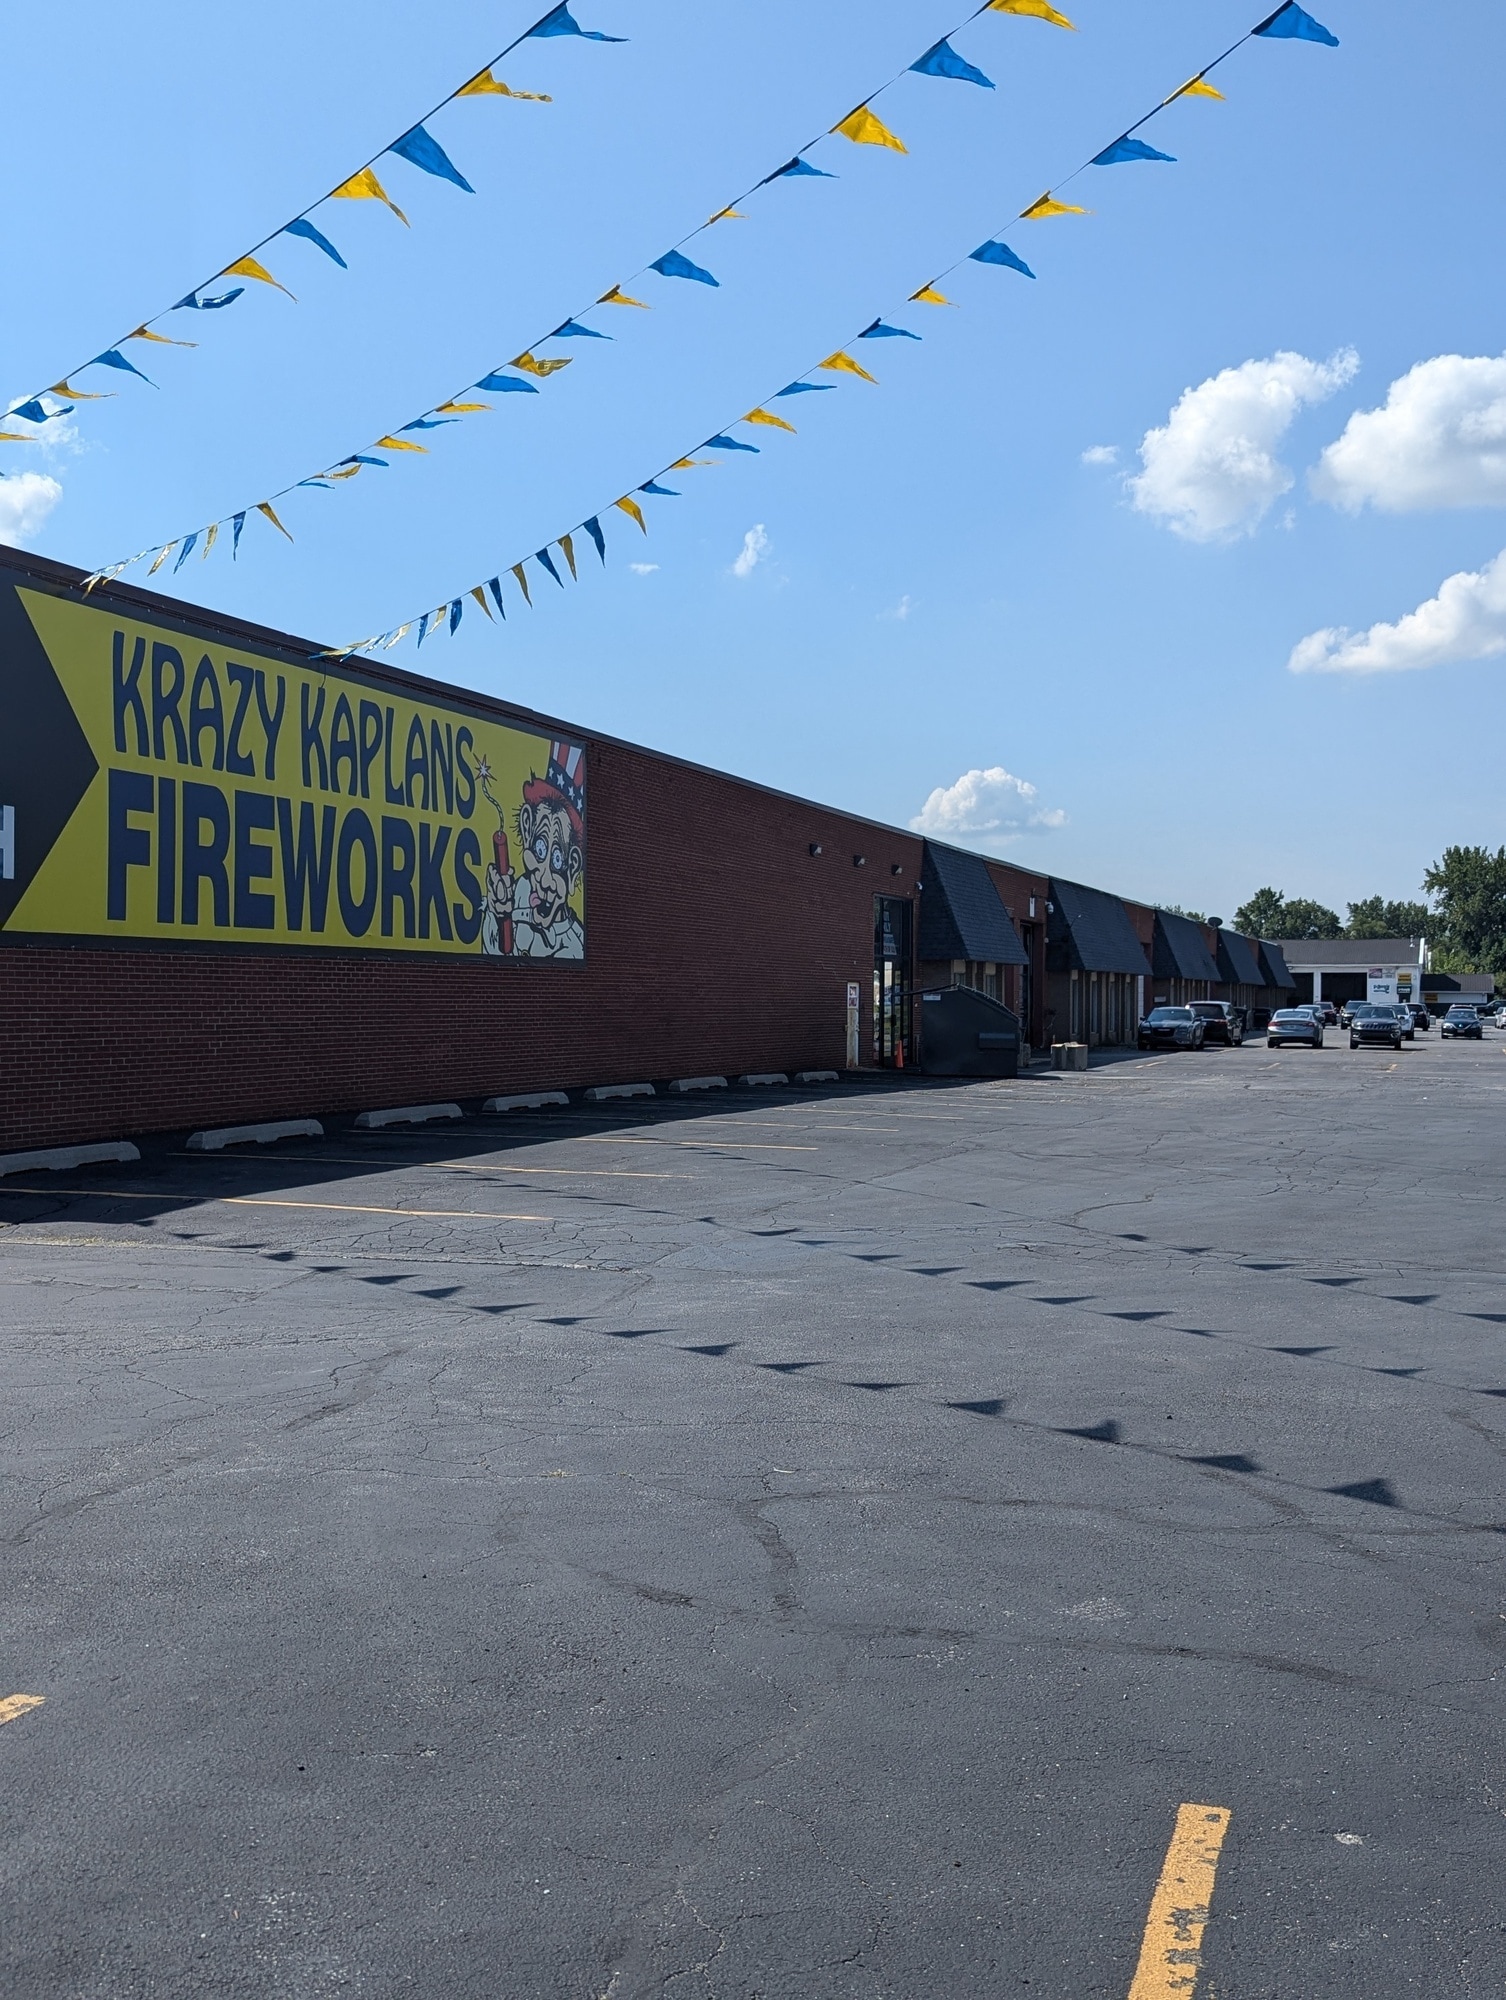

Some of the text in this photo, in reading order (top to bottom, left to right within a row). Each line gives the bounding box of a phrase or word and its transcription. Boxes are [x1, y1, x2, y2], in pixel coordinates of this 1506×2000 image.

[112, 630, 475, 819] KRAZY KAPLANS
[106, 768, 482, 944] FIREWORKS
